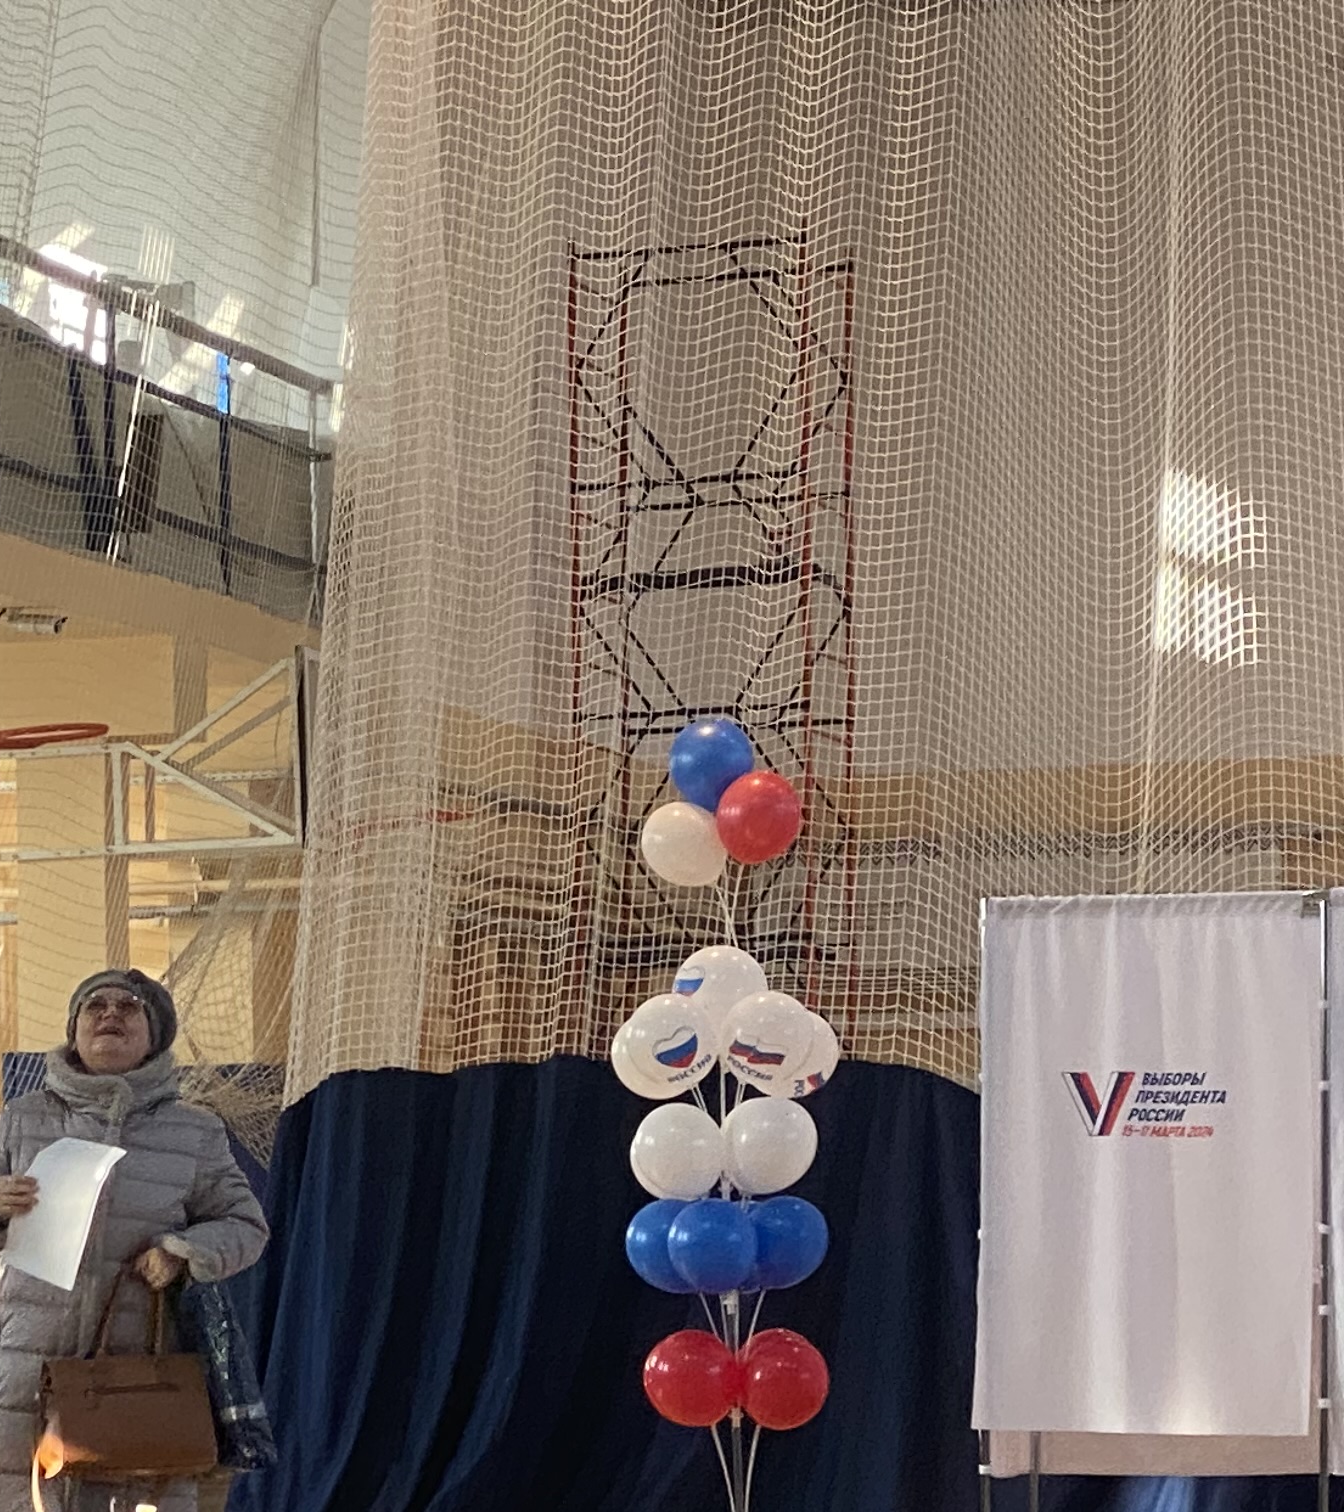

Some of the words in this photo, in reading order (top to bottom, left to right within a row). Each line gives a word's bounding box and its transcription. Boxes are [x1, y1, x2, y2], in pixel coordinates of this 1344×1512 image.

[1142, 1072, 1207, 1086] ВЫБОРЫ
[1135, 1090, 1227, 1106] ПРЕЗИДЕНТА
[1128, 1109, 1186, 1122] РОССИИ
